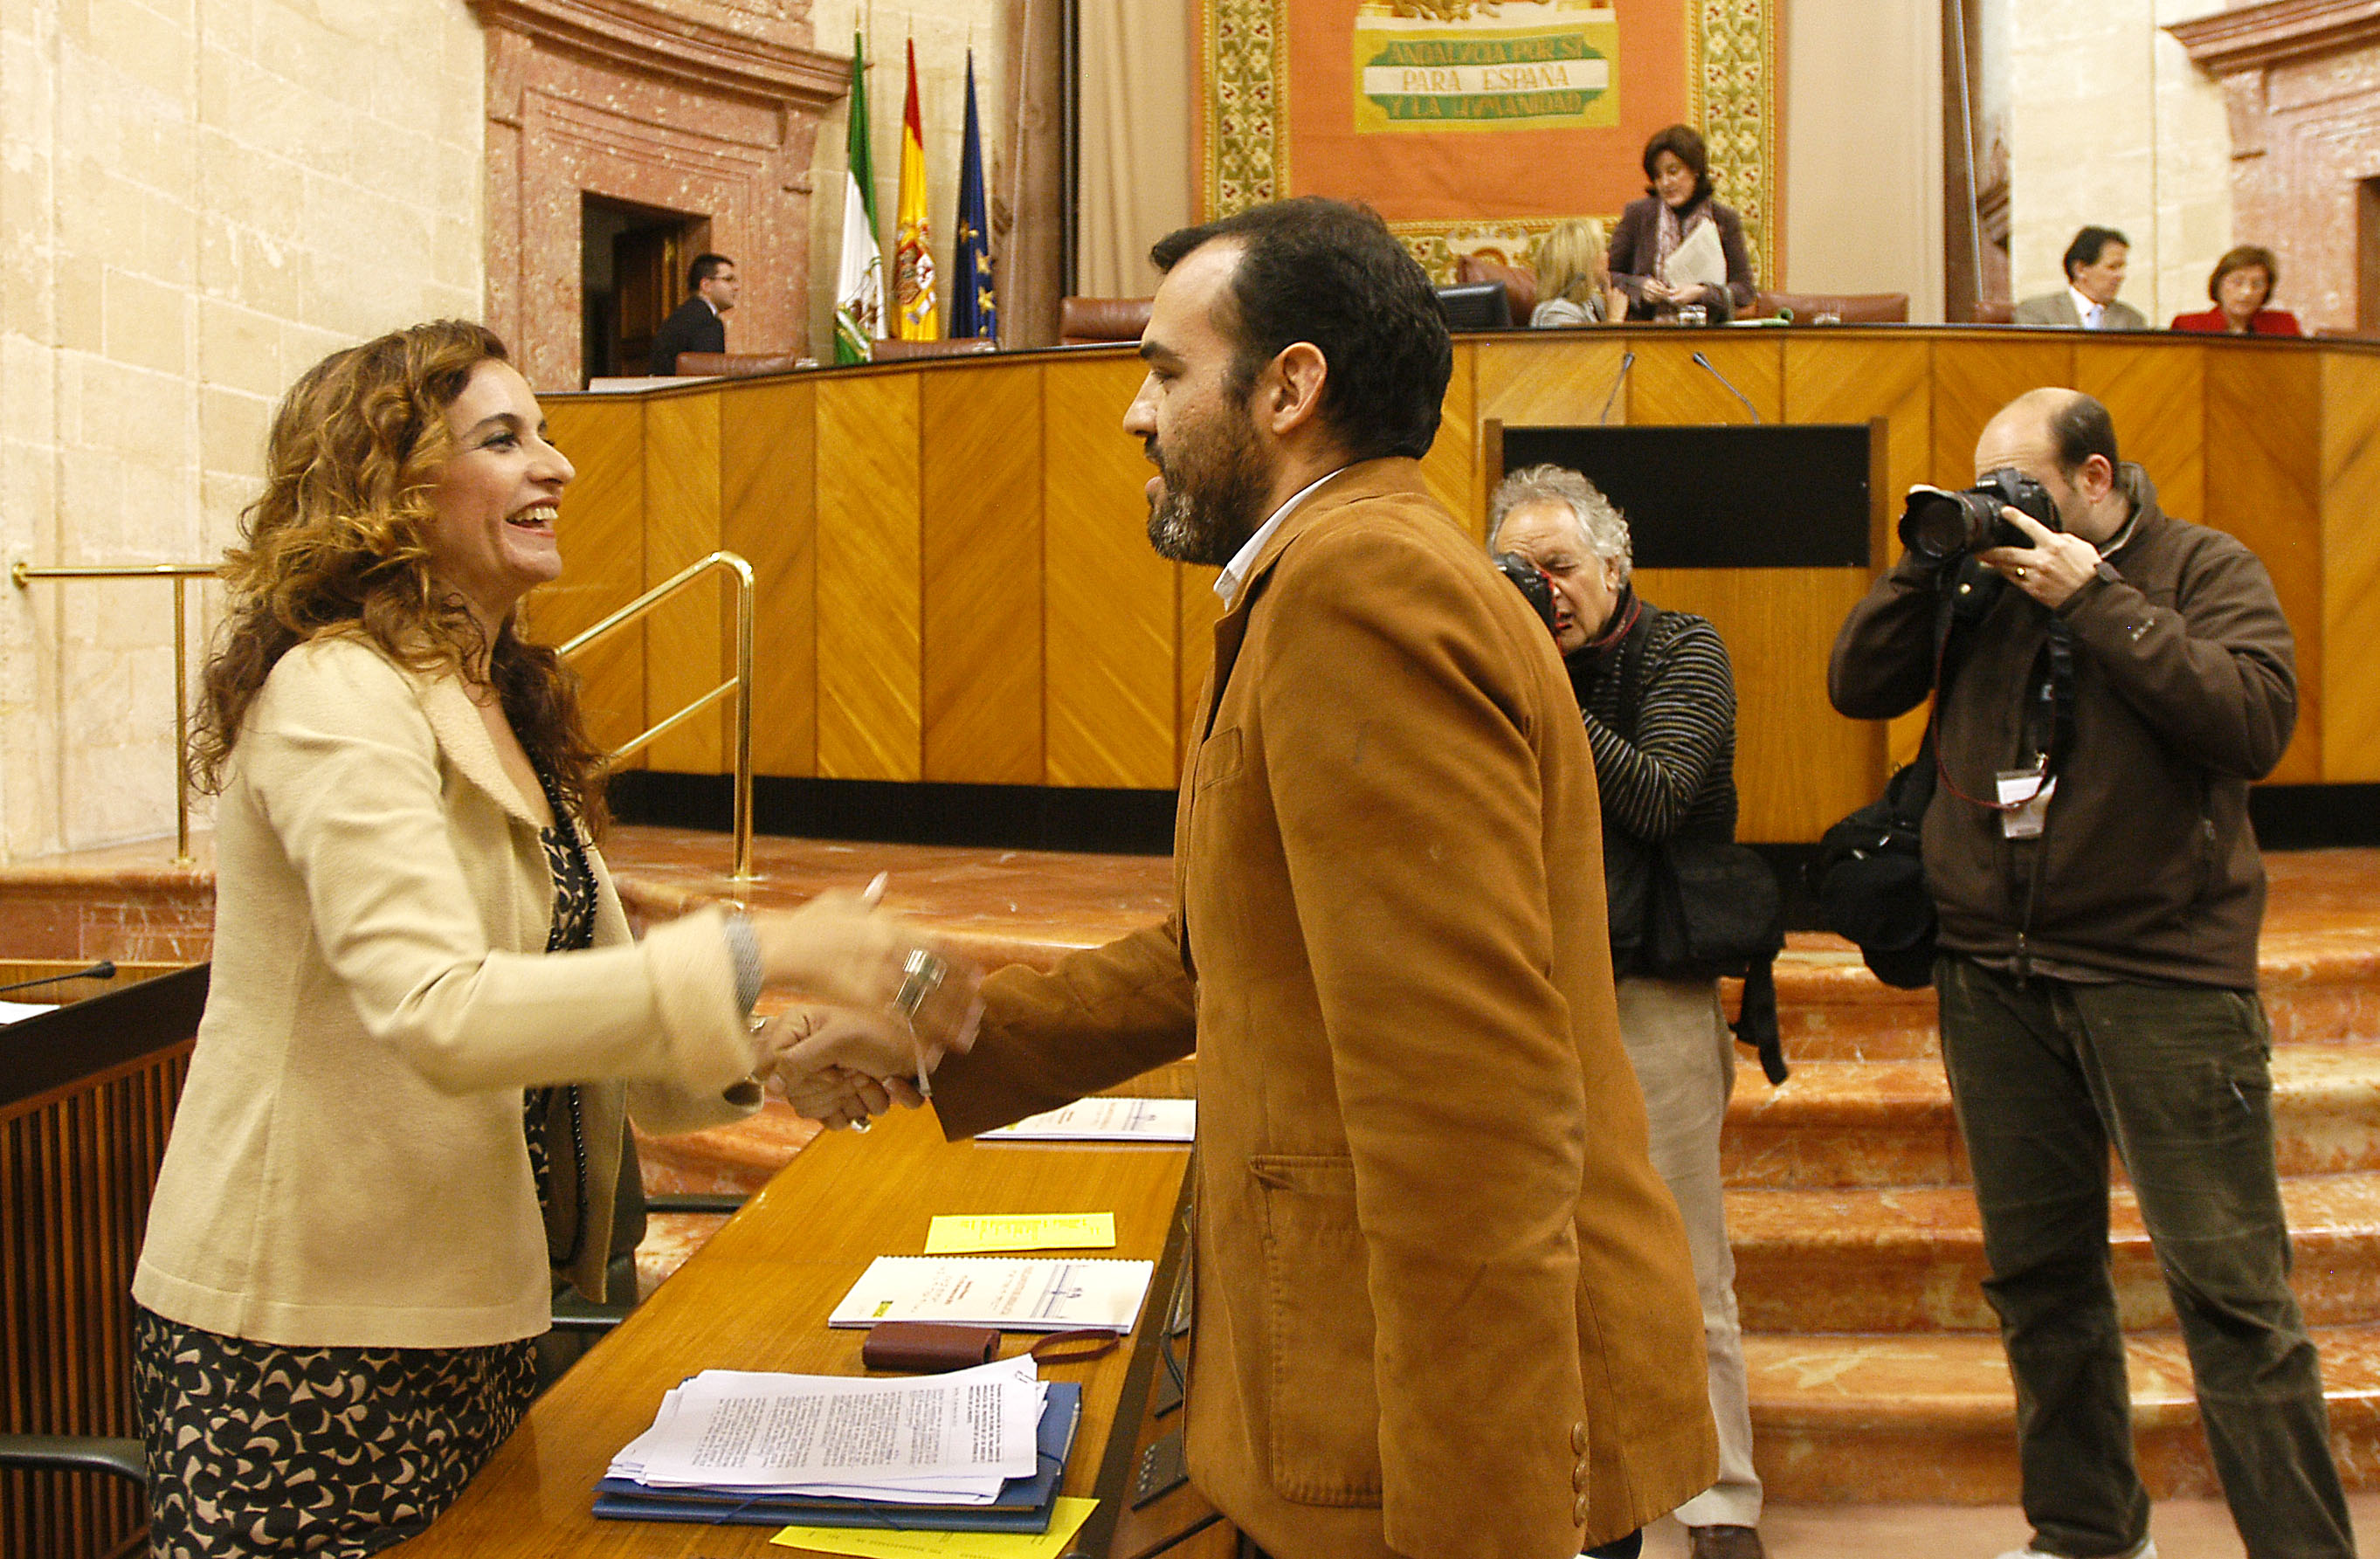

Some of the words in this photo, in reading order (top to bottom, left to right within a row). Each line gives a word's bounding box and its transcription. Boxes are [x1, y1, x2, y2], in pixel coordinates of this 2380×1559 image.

[1403, 69, 1461, 92] PARA
[1482, 62, 1569, 91] ESPAÑA
[1411, 95, 1442, 117] LA
